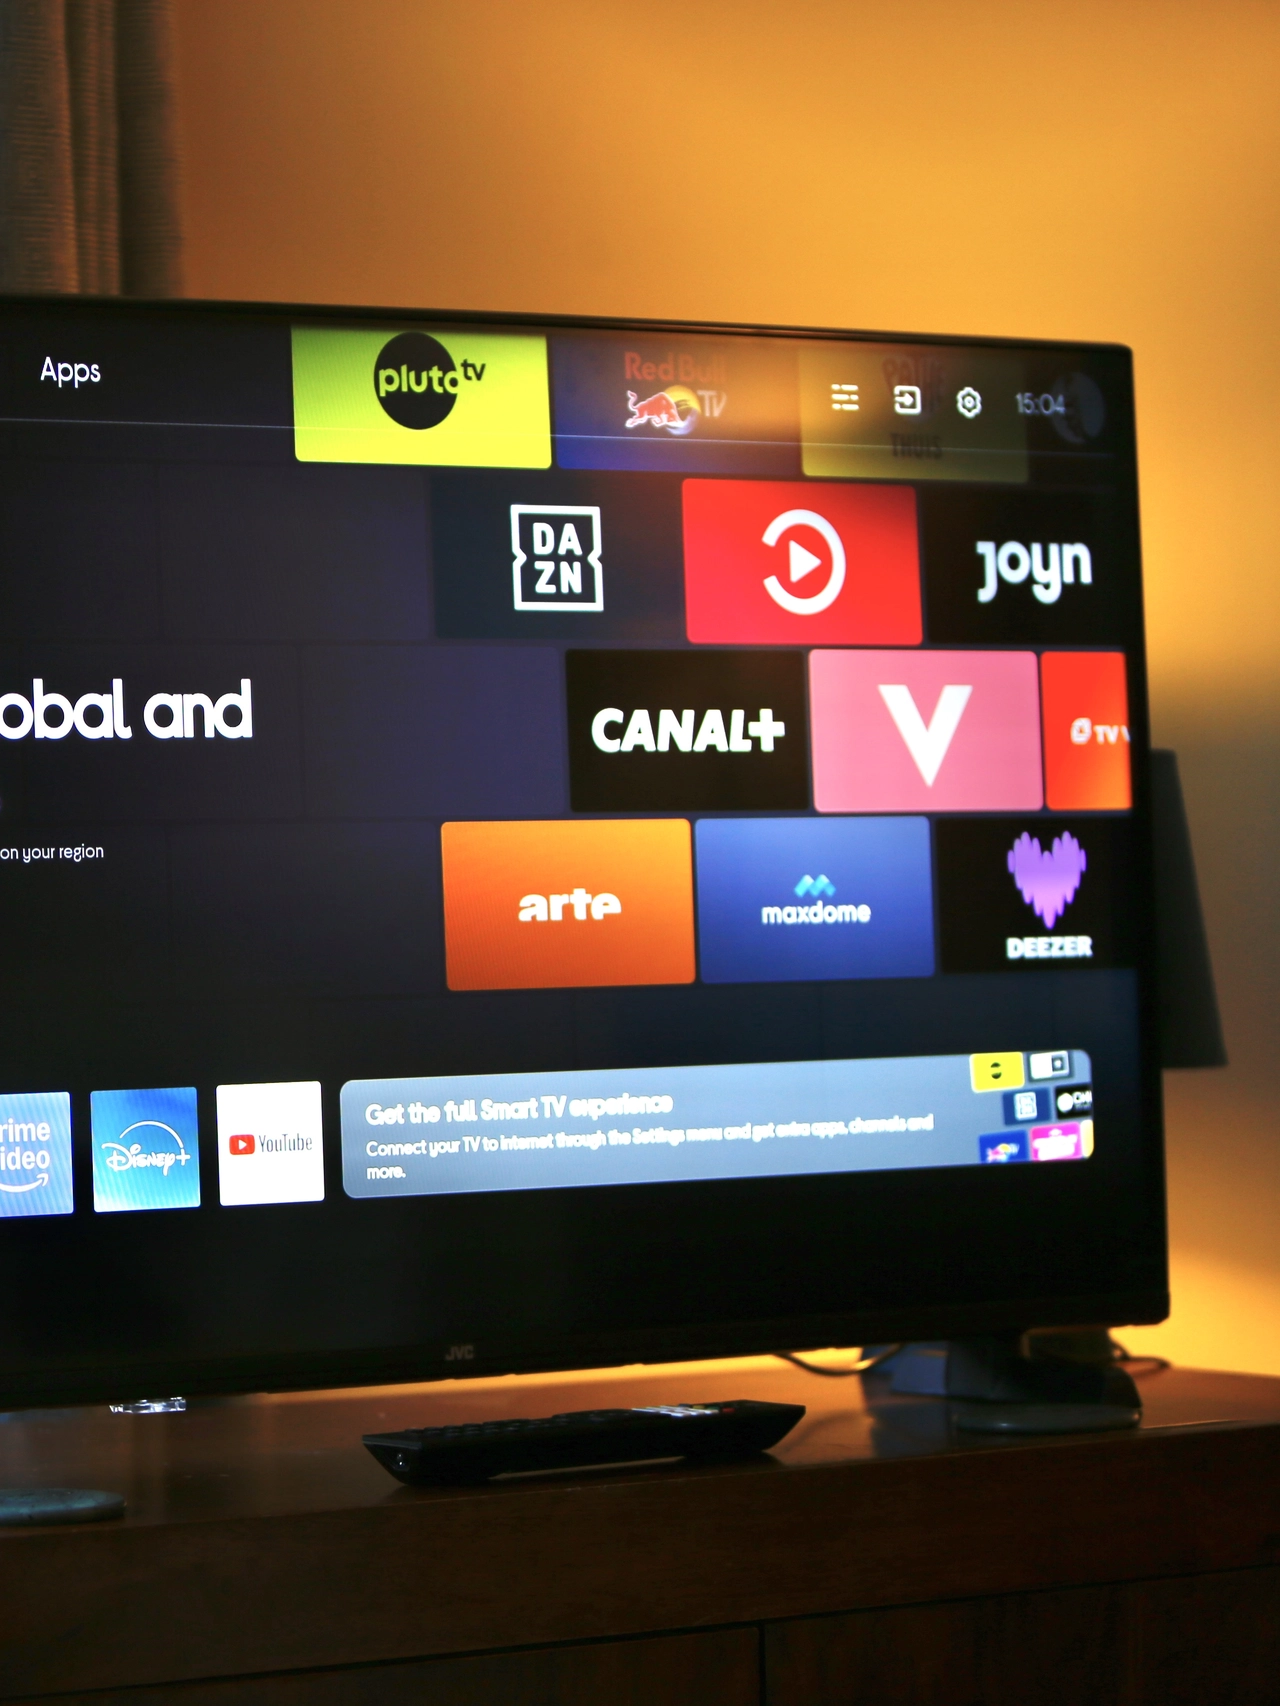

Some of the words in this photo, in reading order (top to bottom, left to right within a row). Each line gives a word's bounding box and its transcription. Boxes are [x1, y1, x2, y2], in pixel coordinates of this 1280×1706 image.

[40, 356, 101, 389] Apps
[379, 363, 459, 397] pluto
[460, 358, 486, 383] tv
[624, 352, 675, 381] Red
[678, 353, 726, 383] Bull
[697, 389, 728, 417] TV
[1015, 392, 1066, 416] 15:04
[976, 540, 1093, 604] joyn
[143, 678, 253, 740] and
[591, 707, 786, 754] CANAL+
[0, 847, 20, 861] on
[22, 847, 56, 865] your
[59, 843, 105, 864] region
[518, 887, 622, 922] arte
[761, 899, 872, 925] maxdome
[1006, 935, 1093, 960] DEEZER
[365, 1103, 405, 1125] Get
[407, 1101, 441, 1124] the
[444, 1099, 478, 1123] full
[480, 1097, 539, 1121] Smart
[540, 1095, 567, 1118] TV
[569, 1092, 674, 1121] experience
[258, 1133, 313, 1153] YouTube
[365, 1139, 427, 1158] Connect
[428, 1138, 461, 1158] your
[462, 1135, 480, 1153] TV
[482, 1135, 499, 1151] to
[555, 1130, 607, 1151] through
[607, 1128, 632, 1146] the
[632, 1126, 686, 1147] Settings
[723, 1122, 752, 1140] and
[907, 1112, 934, 1132] and
[366, 1165, 407, 1180] more.
[445, 1345, 475, 1361] JVC
